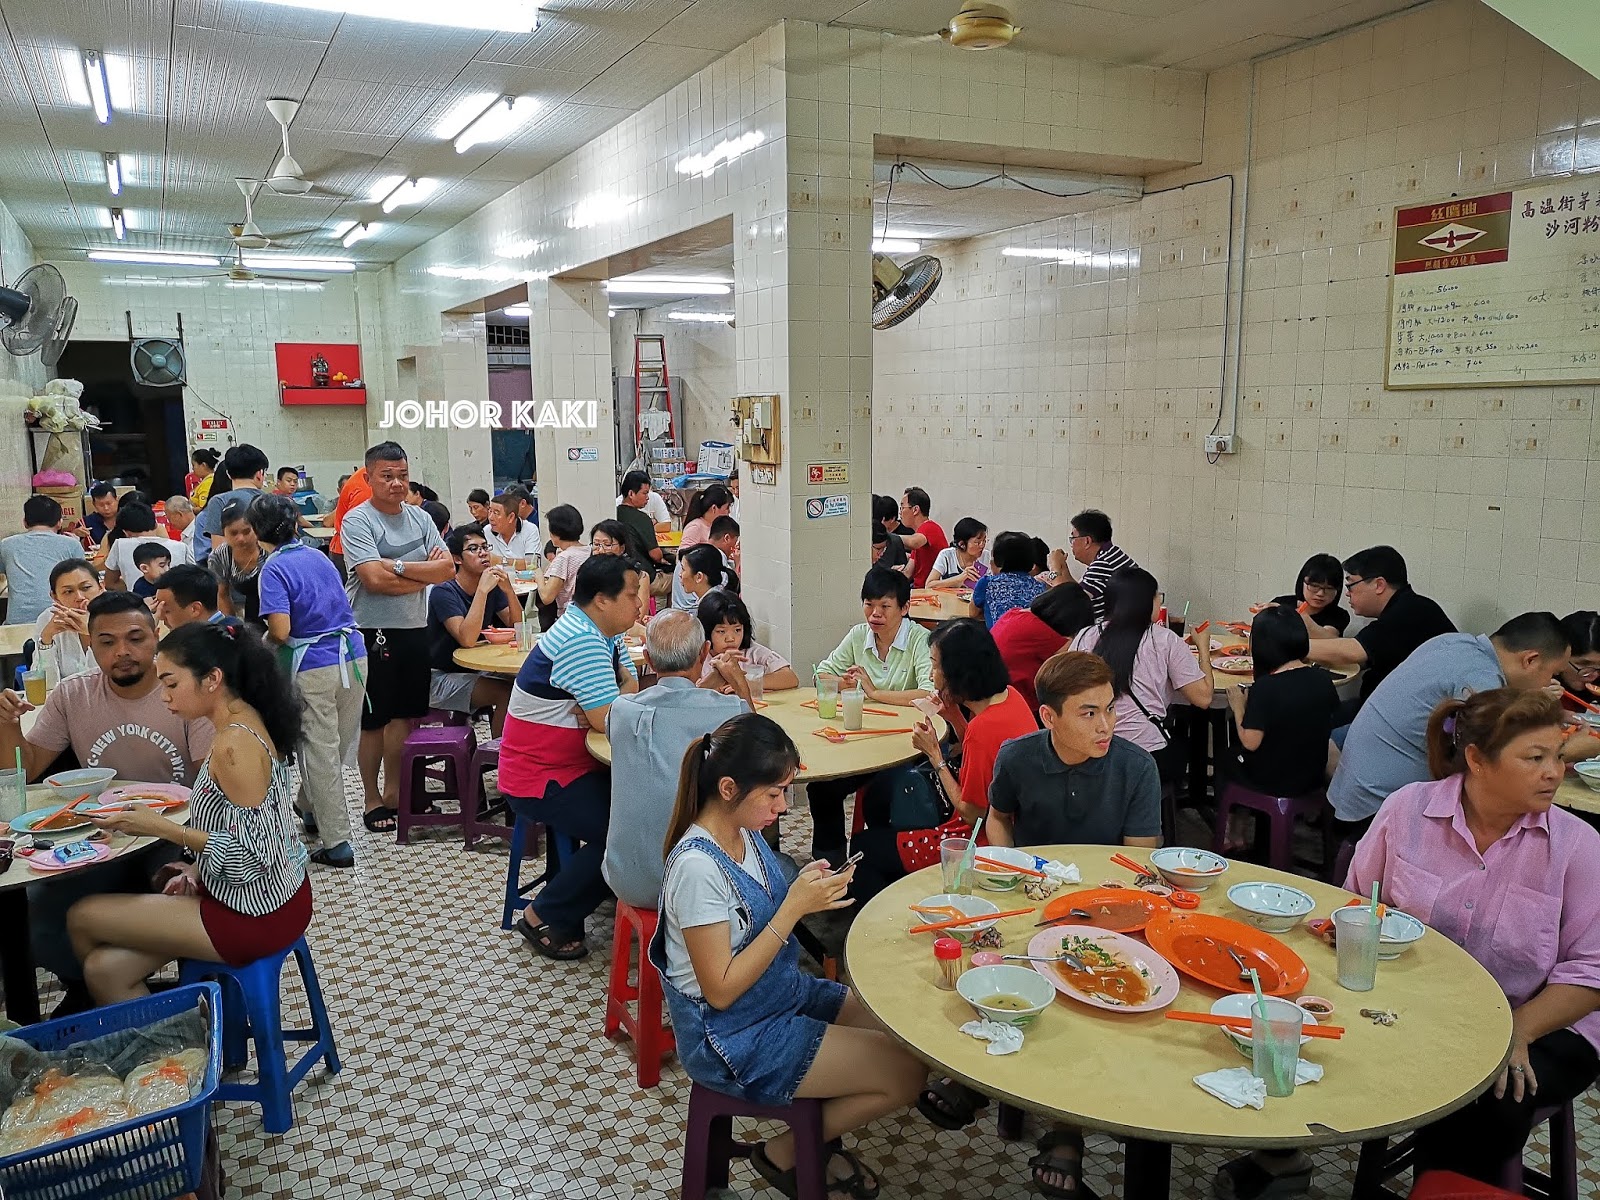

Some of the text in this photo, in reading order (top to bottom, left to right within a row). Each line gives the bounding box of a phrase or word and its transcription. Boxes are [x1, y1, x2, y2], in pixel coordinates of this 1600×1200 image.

[90, 729, 117, 756] NEW
[117, 723, 150, 739] YORK
[150, 731, 178, 754] CITY
